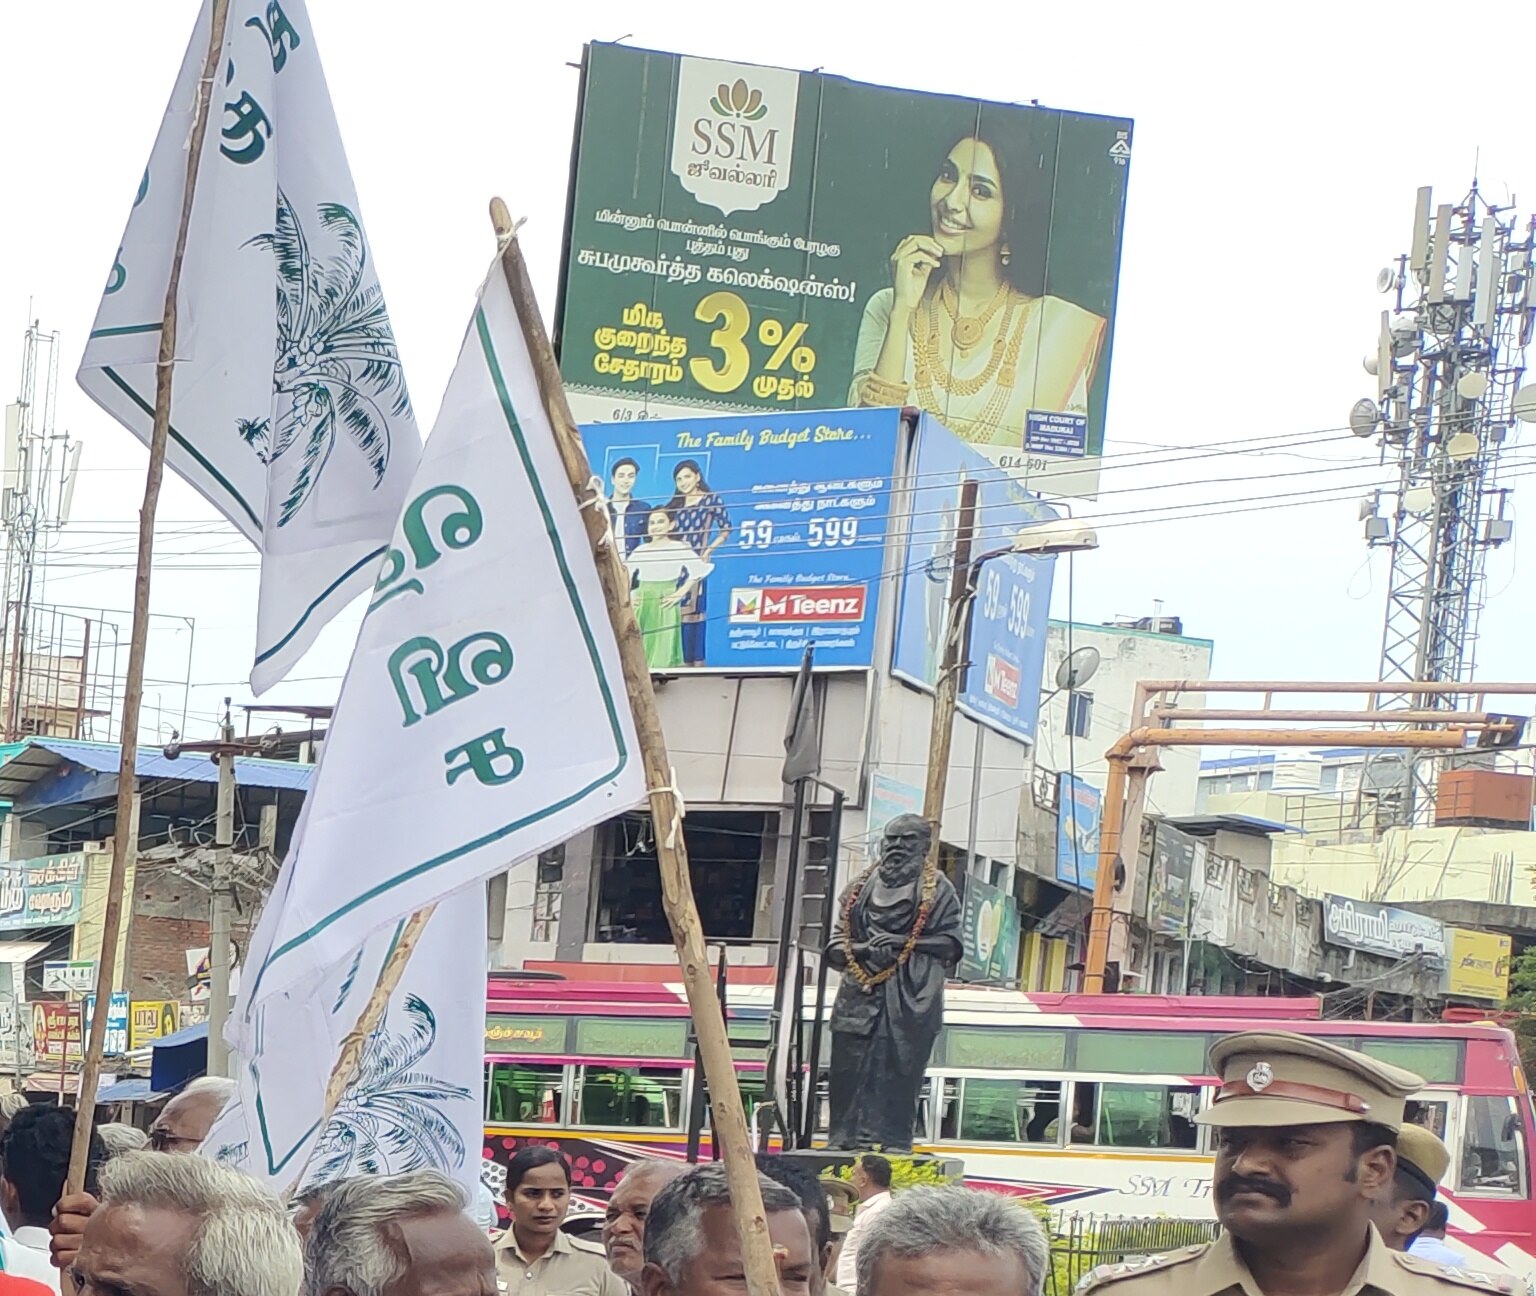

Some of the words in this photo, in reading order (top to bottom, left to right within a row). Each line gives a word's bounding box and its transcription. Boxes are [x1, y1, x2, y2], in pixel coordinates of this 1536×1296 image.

[691, 118, 779, 166] SSM
[595, 208, 655, 231] மின்னும்
[657, 219, 727, 239] பொன்னில்
[730, 229, 791, 249] பொங்கும்
[623, 303, 663, 330] மிக
[594, 326, 688, 359] குறைந்த
[594, 352, 684, 385] சேதாரம்
[753, 374, 815, 400] முதல்
[677, 432, 701, 449] The
[705, 429, 753, 451] Family
[759, 427, 810, 449] Budget
[739, 519, 773, 549] 59
[807, 517, 858, 547] 599
[983, 569, 1000, 621] 59
[1008, 584, 1031, 639] 599
[1184, 1178, 1214, 1198] Tr
